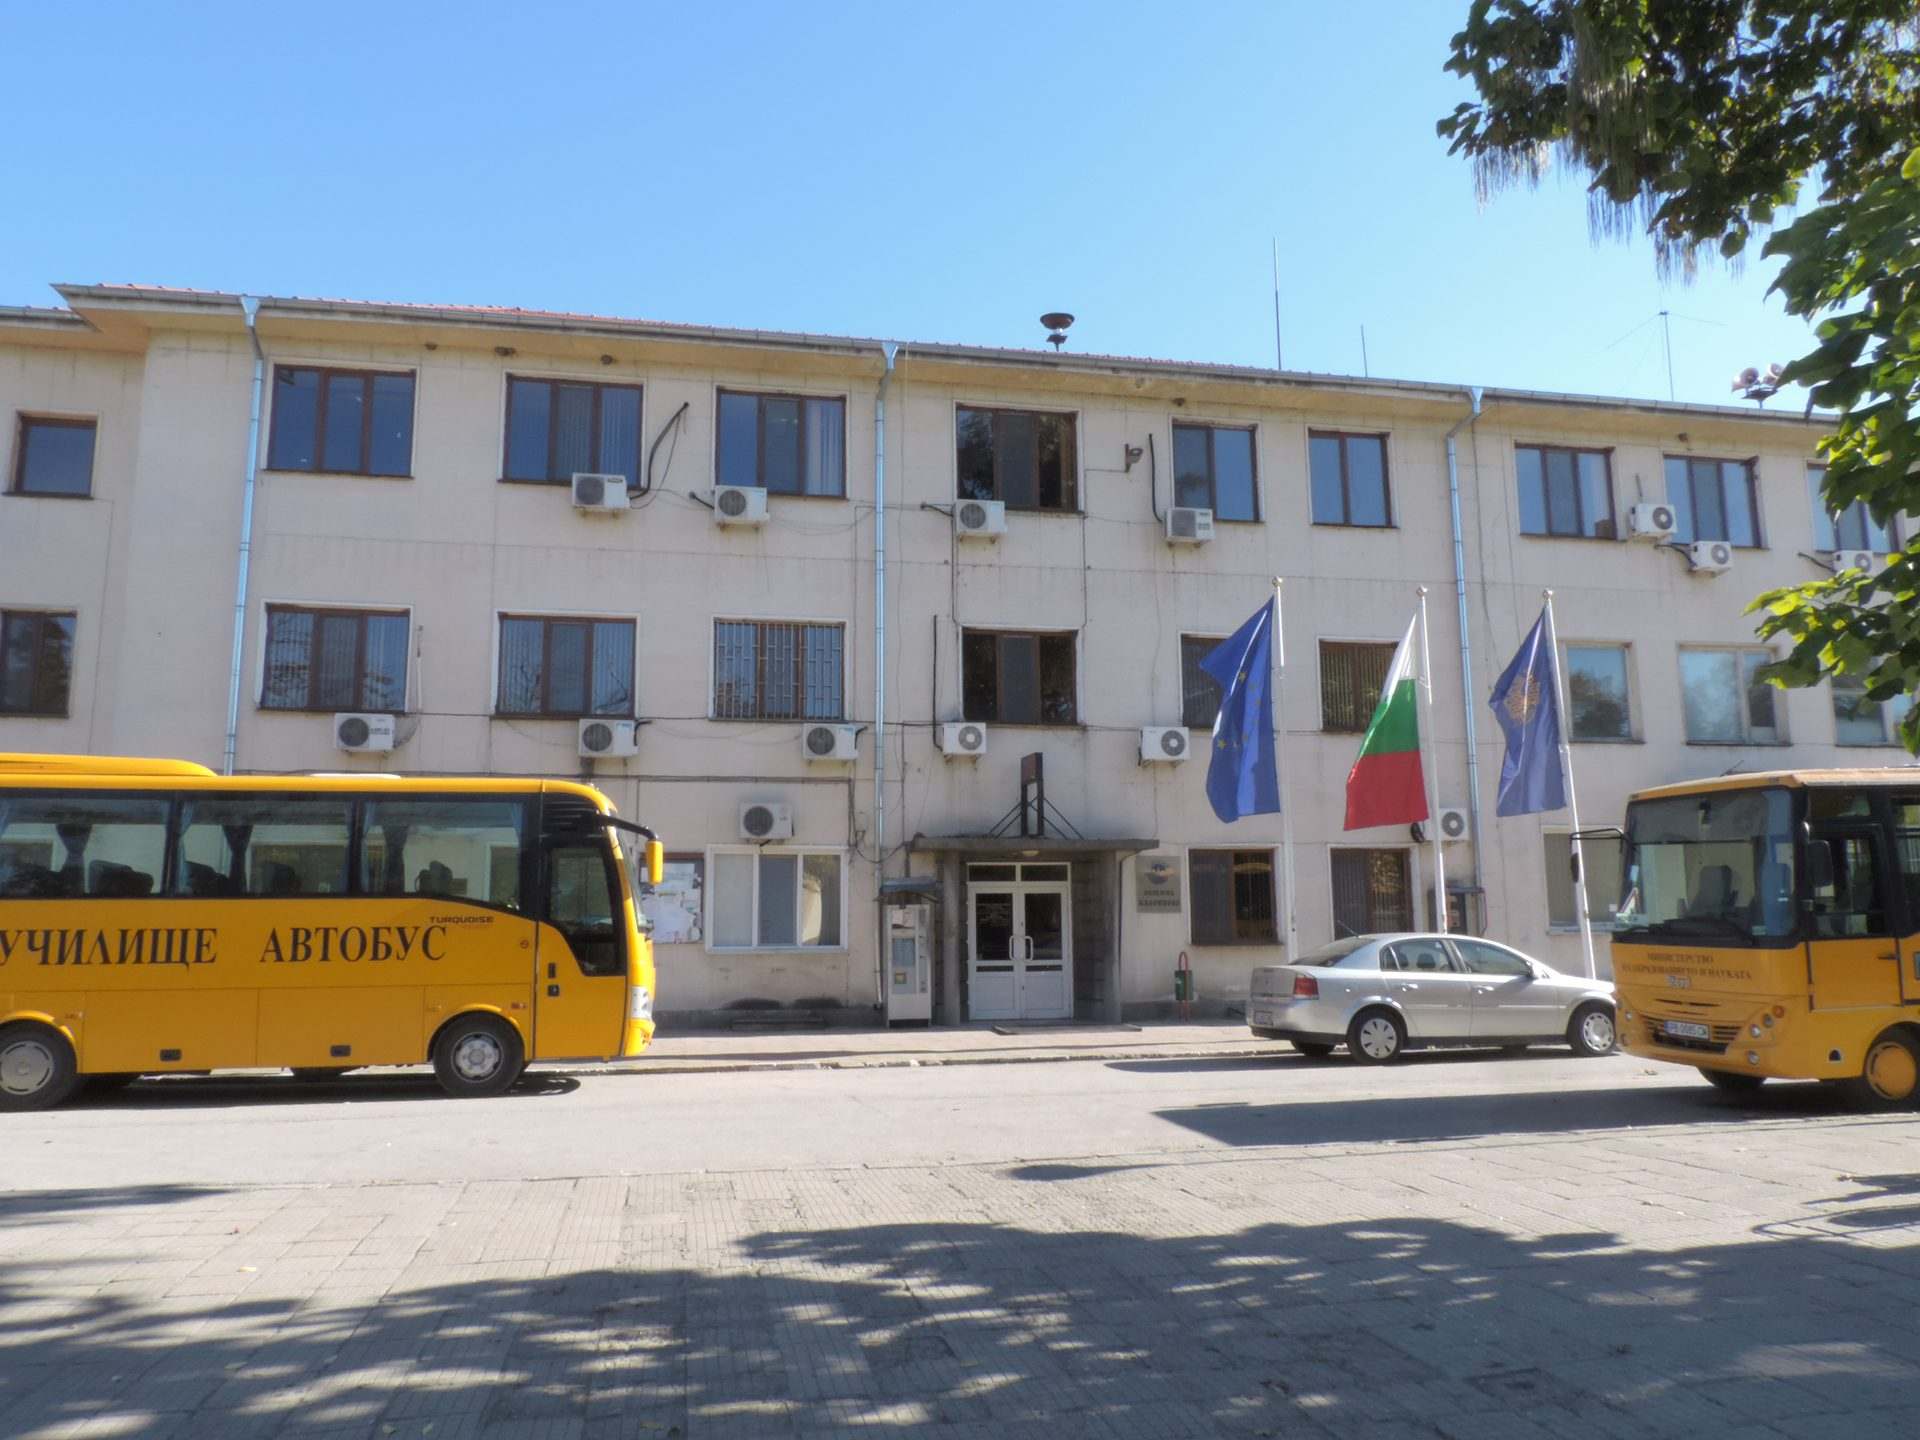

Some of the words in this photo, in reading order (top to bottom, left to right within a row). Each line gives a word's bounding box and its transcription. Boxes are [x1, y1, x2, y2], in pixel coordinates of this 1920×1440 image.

[429, 915, 494, 924] TURQUOISE
[0, 928, 218, 971] УЧИЛИЩЕ
[259, 925, 447, 963] АВТОБУС
